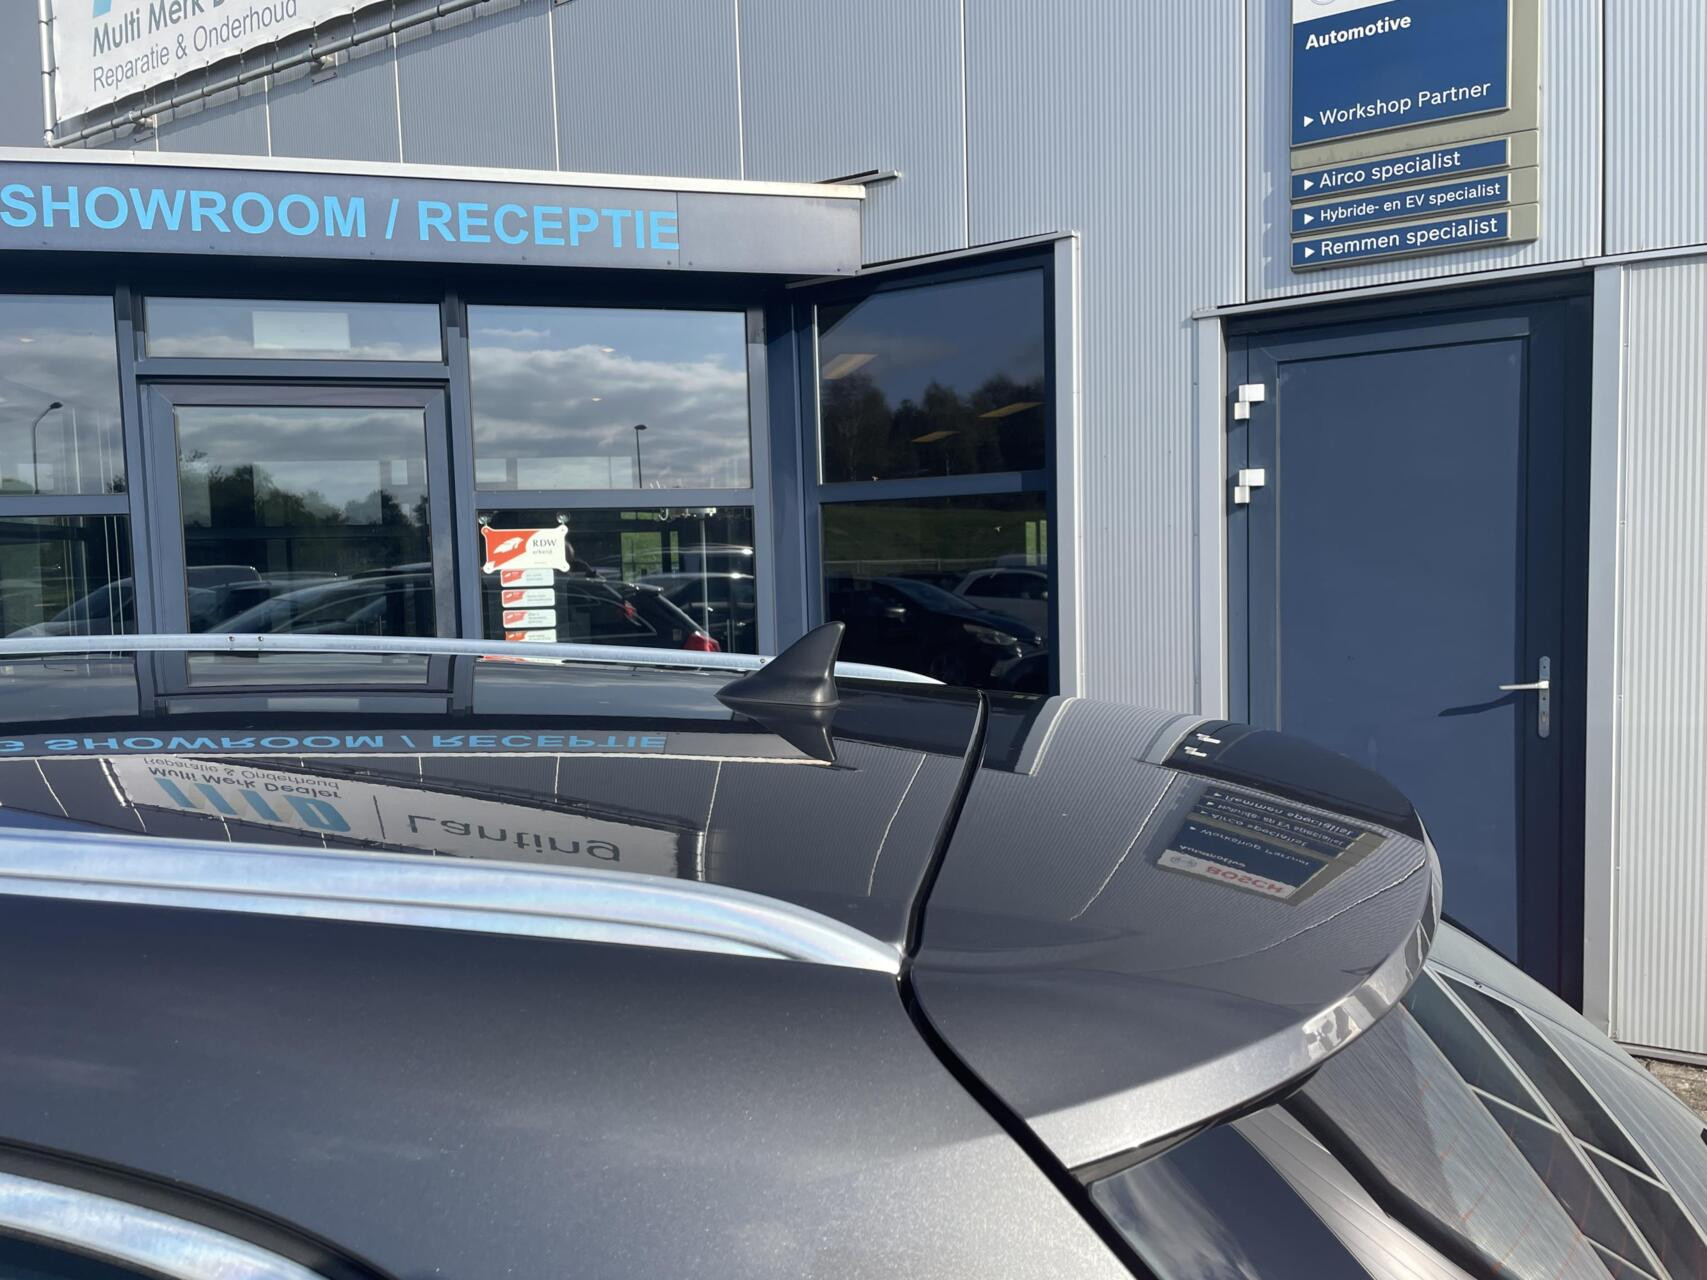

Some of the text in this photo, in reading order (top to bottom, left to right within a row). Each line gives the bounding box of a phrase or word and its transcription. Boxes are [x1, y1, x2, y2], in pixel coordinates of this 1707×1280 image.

[93, 0, 205, 57] Multi Merk
[93, 0, 297, 92] Reparatie & Onderhoud
[1305, 14, 1412, 50] Automotive
[1319, 82, 1492, 126] Workshop Partner
[1319, 151, 1461, 189] Airco specialist
[0, 184, 680, 251] SHOWROOM / RECEPTIE
[1320, 182, 1501, 225] Hybride- en EV specialist
[1321, 218, 1498, 257] Remmen specialist
[532, 538, 557, 548] RDW
